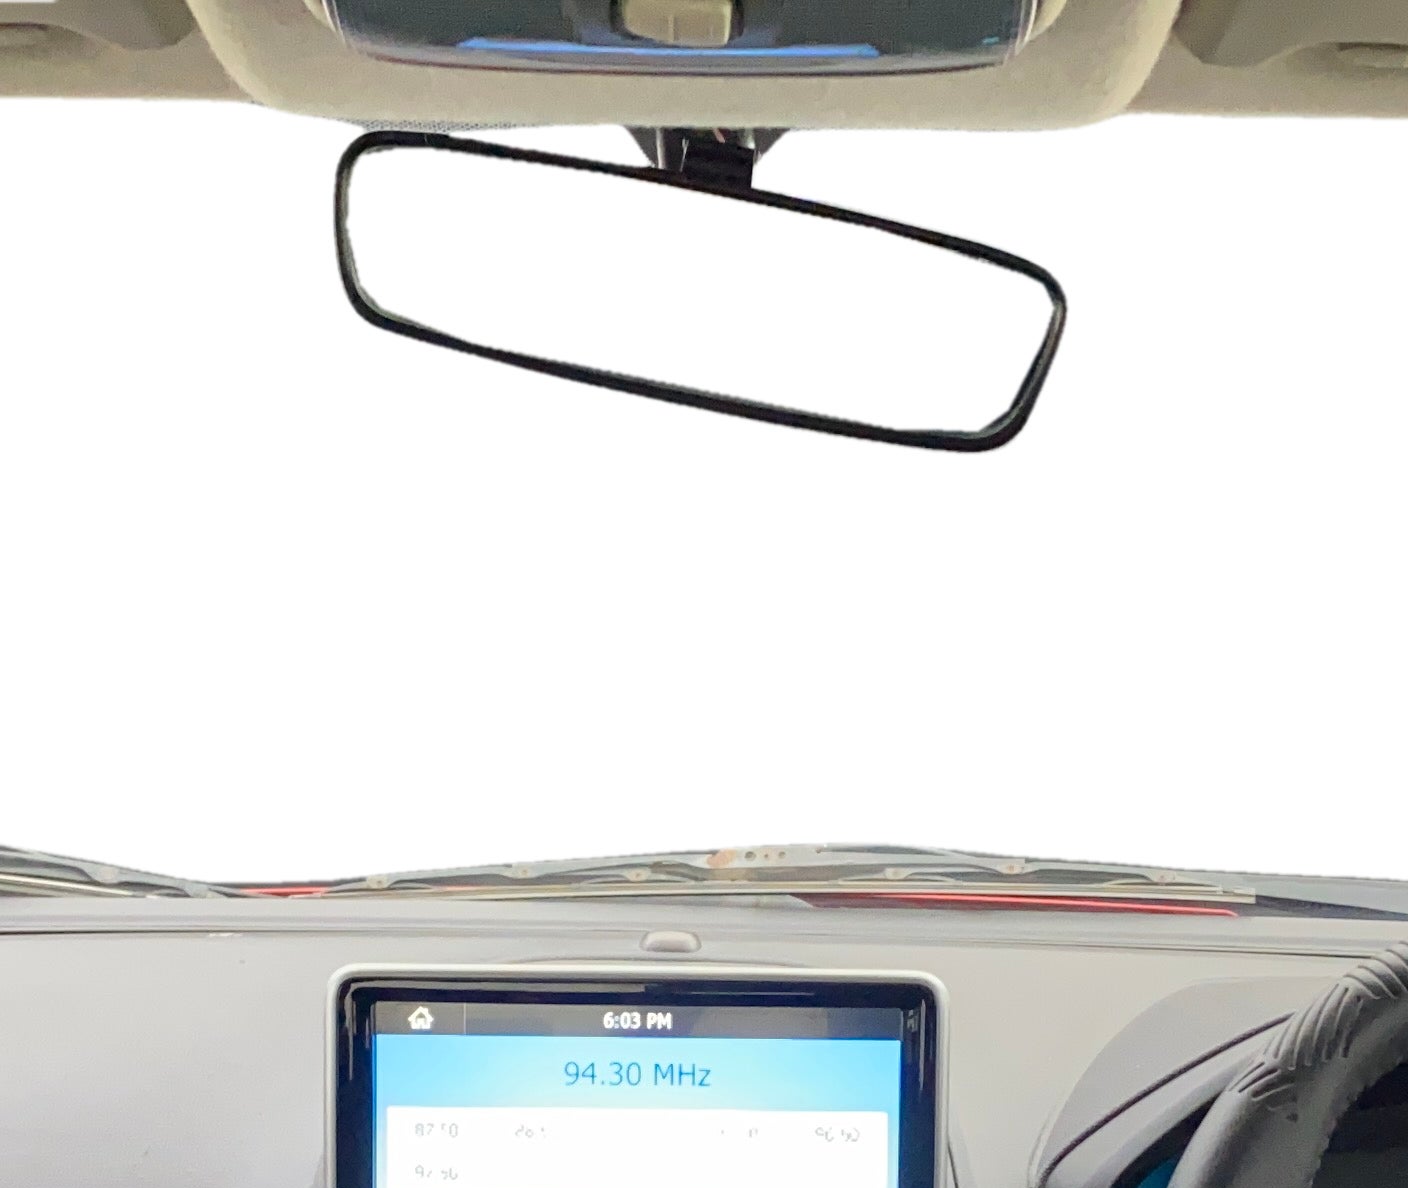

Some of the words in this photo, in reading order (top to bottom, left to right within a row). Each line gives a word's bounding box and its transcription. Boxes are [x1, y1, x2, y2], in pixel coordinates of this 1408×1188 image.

[603, 1011, 641, 1029] 6:03
[646, 1012, 673, 1030] PM
[564, 1061, 641, 1086] 94.30
[653, 1062, 711, 1087] MHz
